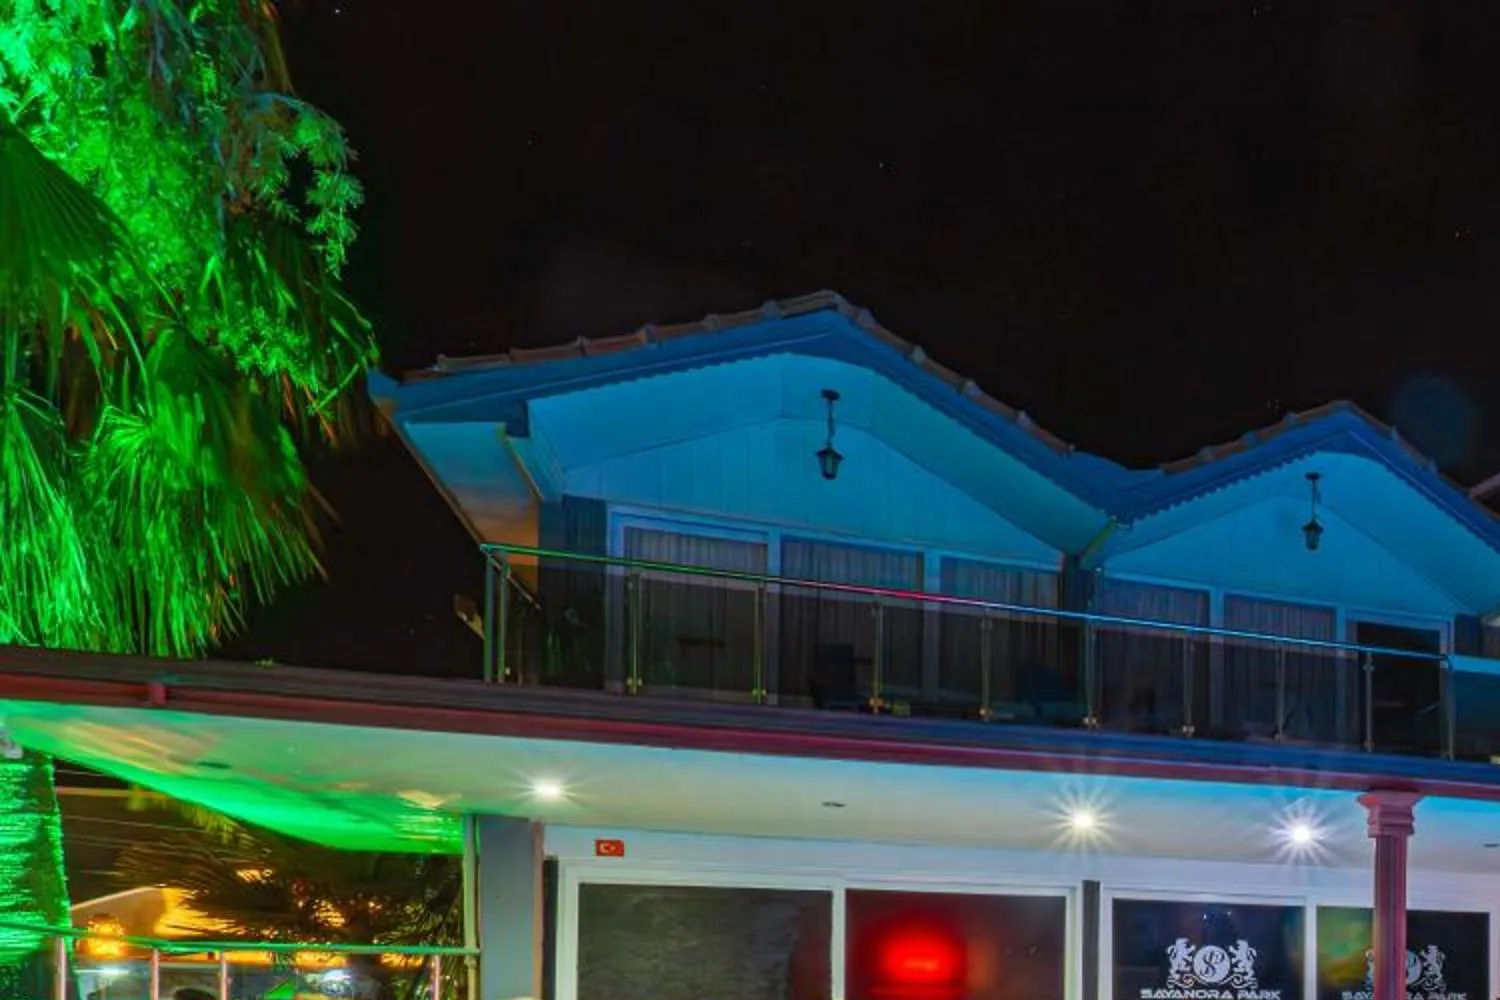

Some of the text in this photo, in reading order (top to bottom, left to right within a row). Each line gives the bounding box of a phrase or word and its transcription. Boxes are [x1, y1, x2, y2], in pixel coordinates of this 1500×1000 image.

[1140, 989, 1281, 1000] SAYANORA PARK
[1341, 991, 1424, 1000] SAYRA
